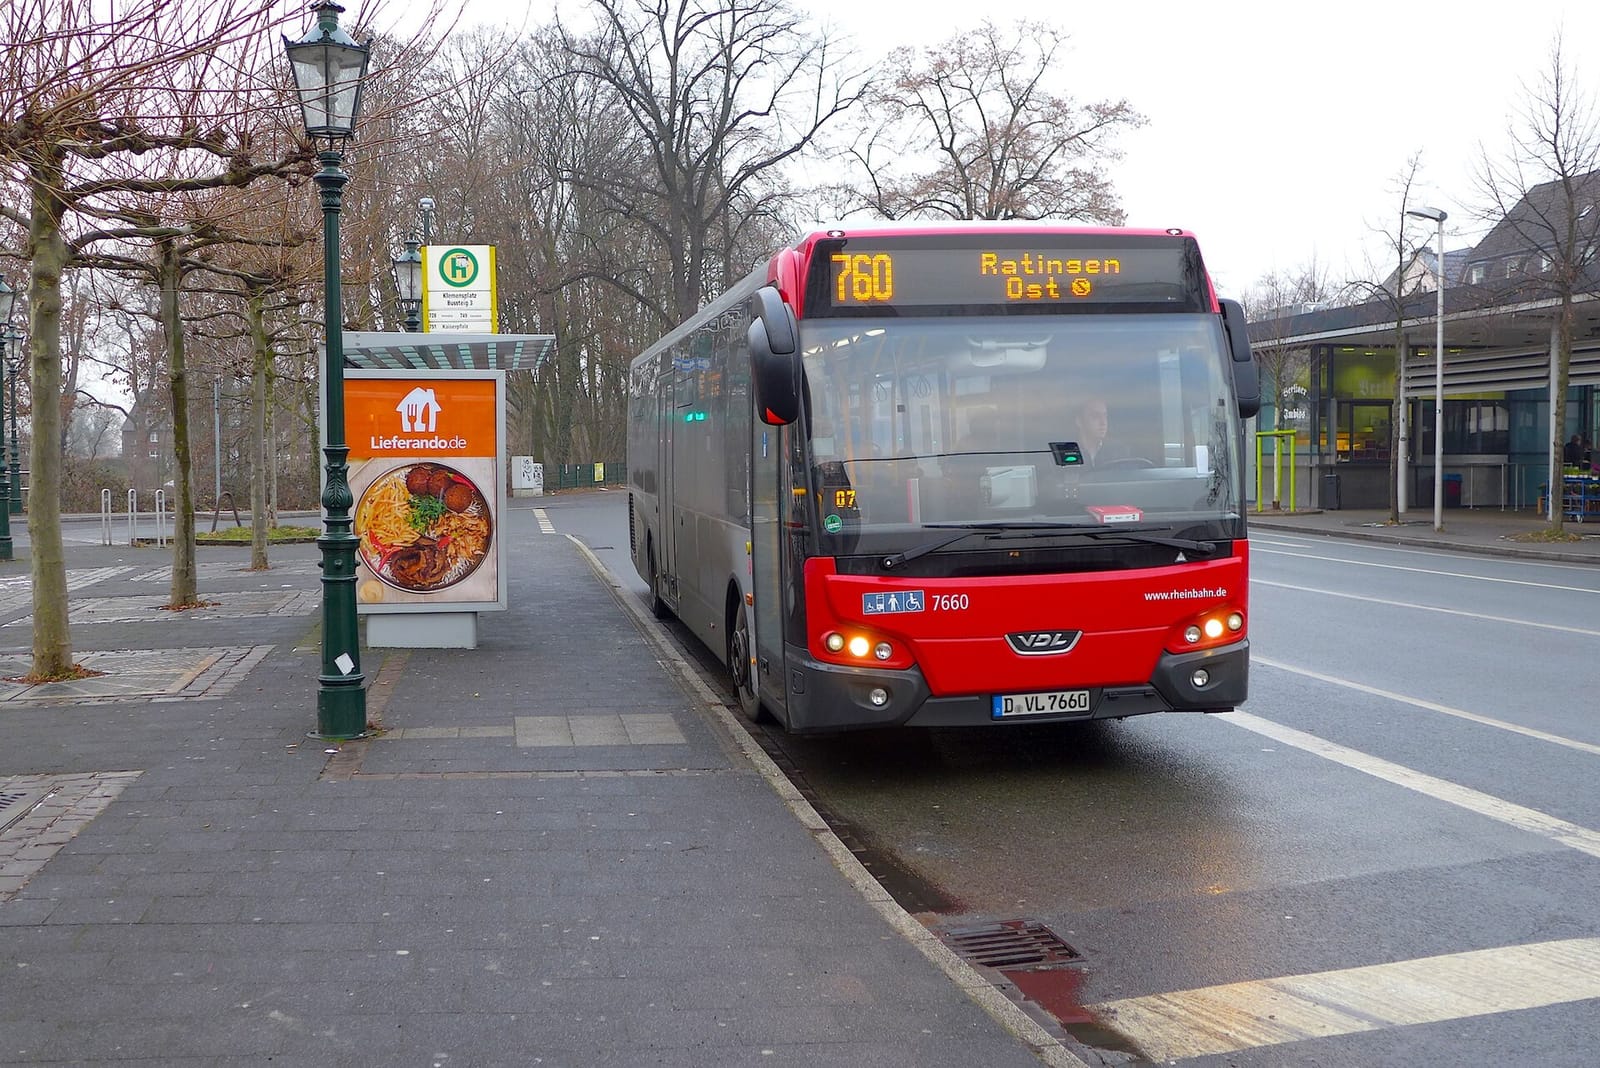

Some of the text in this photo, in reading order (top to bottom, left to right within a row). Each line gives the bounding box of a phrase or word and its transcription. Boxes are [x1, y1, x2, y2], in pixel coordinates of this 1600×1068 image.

[831, 253, 893, 302] 760
[1006, 276, 1060, 299] Ost
[370, 435, 467, 449] Lieferando.de
[835, 489, 856, 508] 07
[931, 593, 969, 611] 7660
[1144, 587, 1228, 601] www.rheinbahn.de
[1017, 633, 1068, 648] VDL
[1003, 692, 1088, 714] D VL 7660
